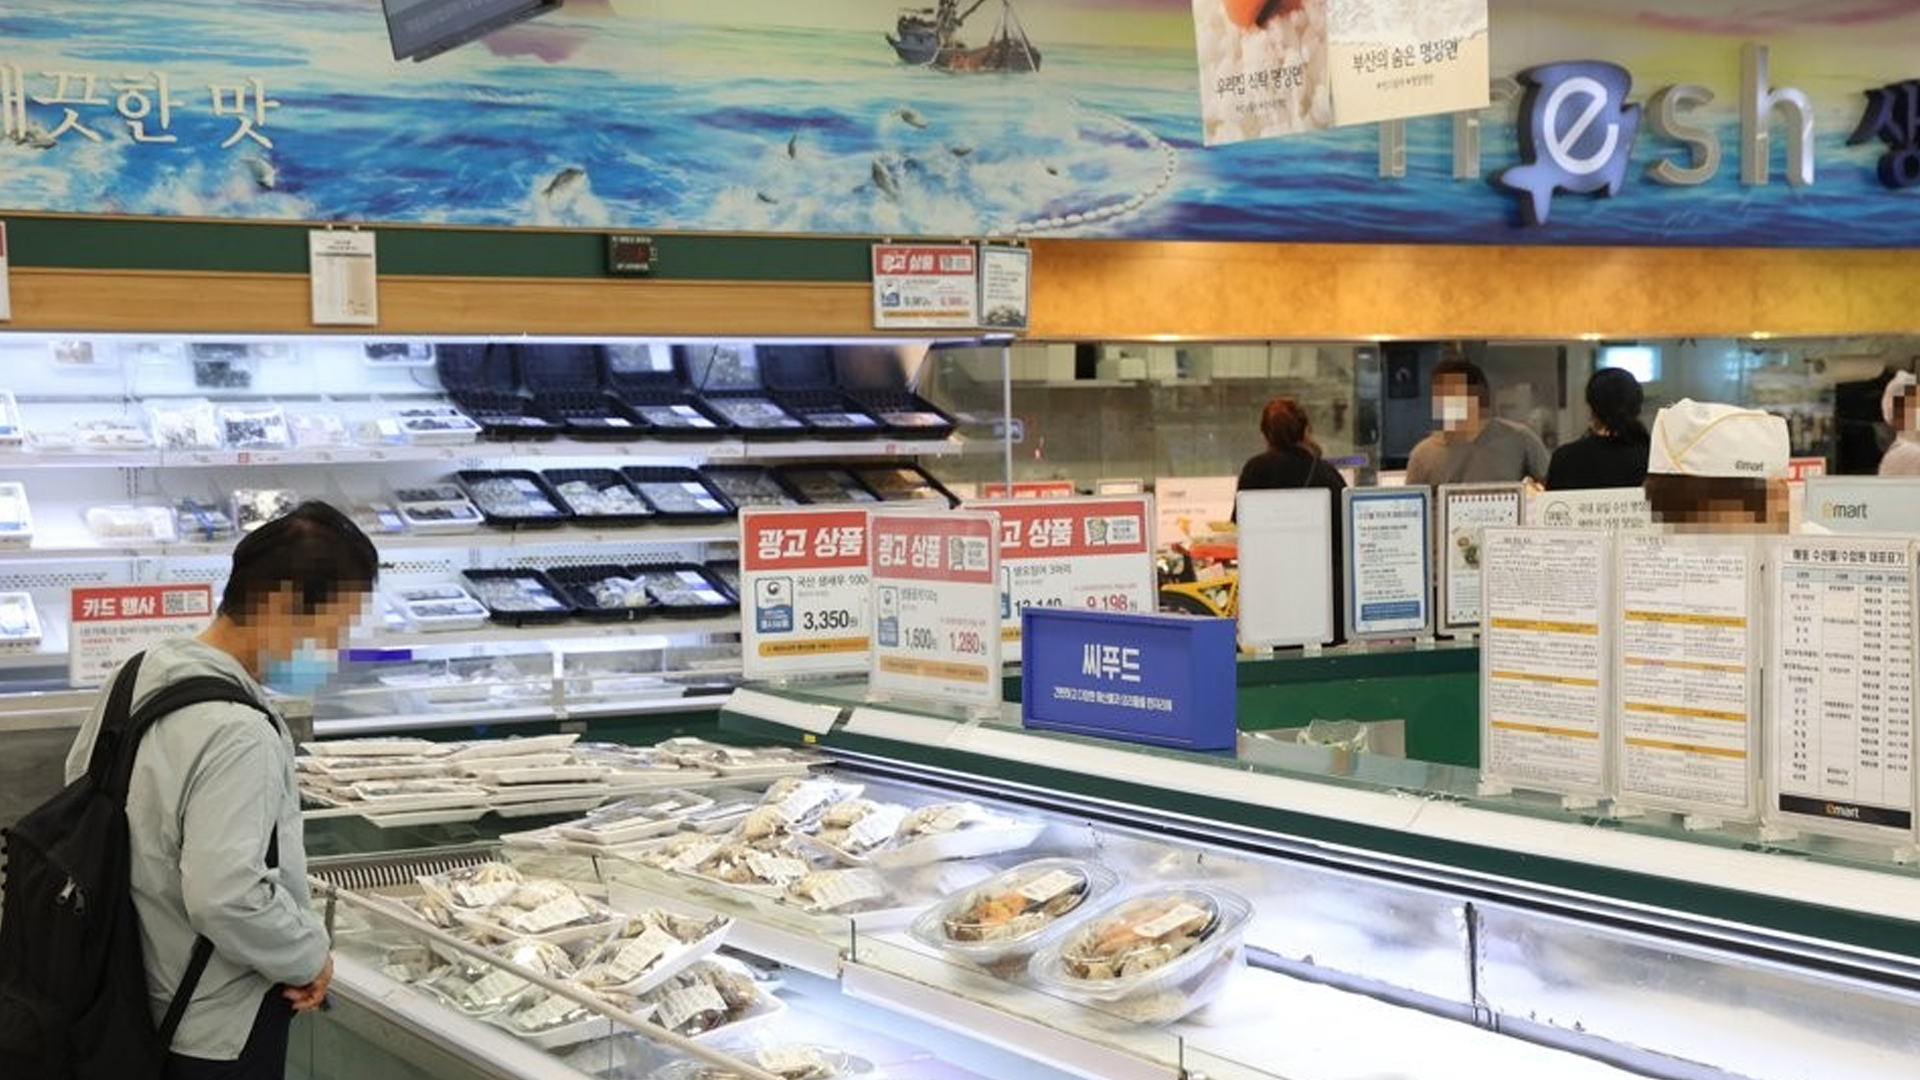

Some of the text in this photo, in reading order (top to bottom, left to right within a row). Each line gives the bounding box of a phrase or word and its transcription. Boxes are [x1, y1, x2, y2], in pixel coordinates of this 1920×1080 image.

[1352, 39, 1459, 75] 부산의 숨은 명장면
[1216, 73, 1245, 98] 우리집
[1248, 68, 1269, 90] 식탁
[208, 76, 281, 149] 맛
[882, 254, 934, 271] 광고 상품
[1822, 502, 1868, 519] emart
[758, 526, 864, 560] 광고 상품
[1028, 517, 1073, 548] 상품
[879, 534, 907, 567] 광고
[911, 534, 941, 568] 상품
[797, 575, 815, 588] 국산
[82, 597, 156, 617] 카드 행사
[1082, 643, 1141, 682] 씨푸드
